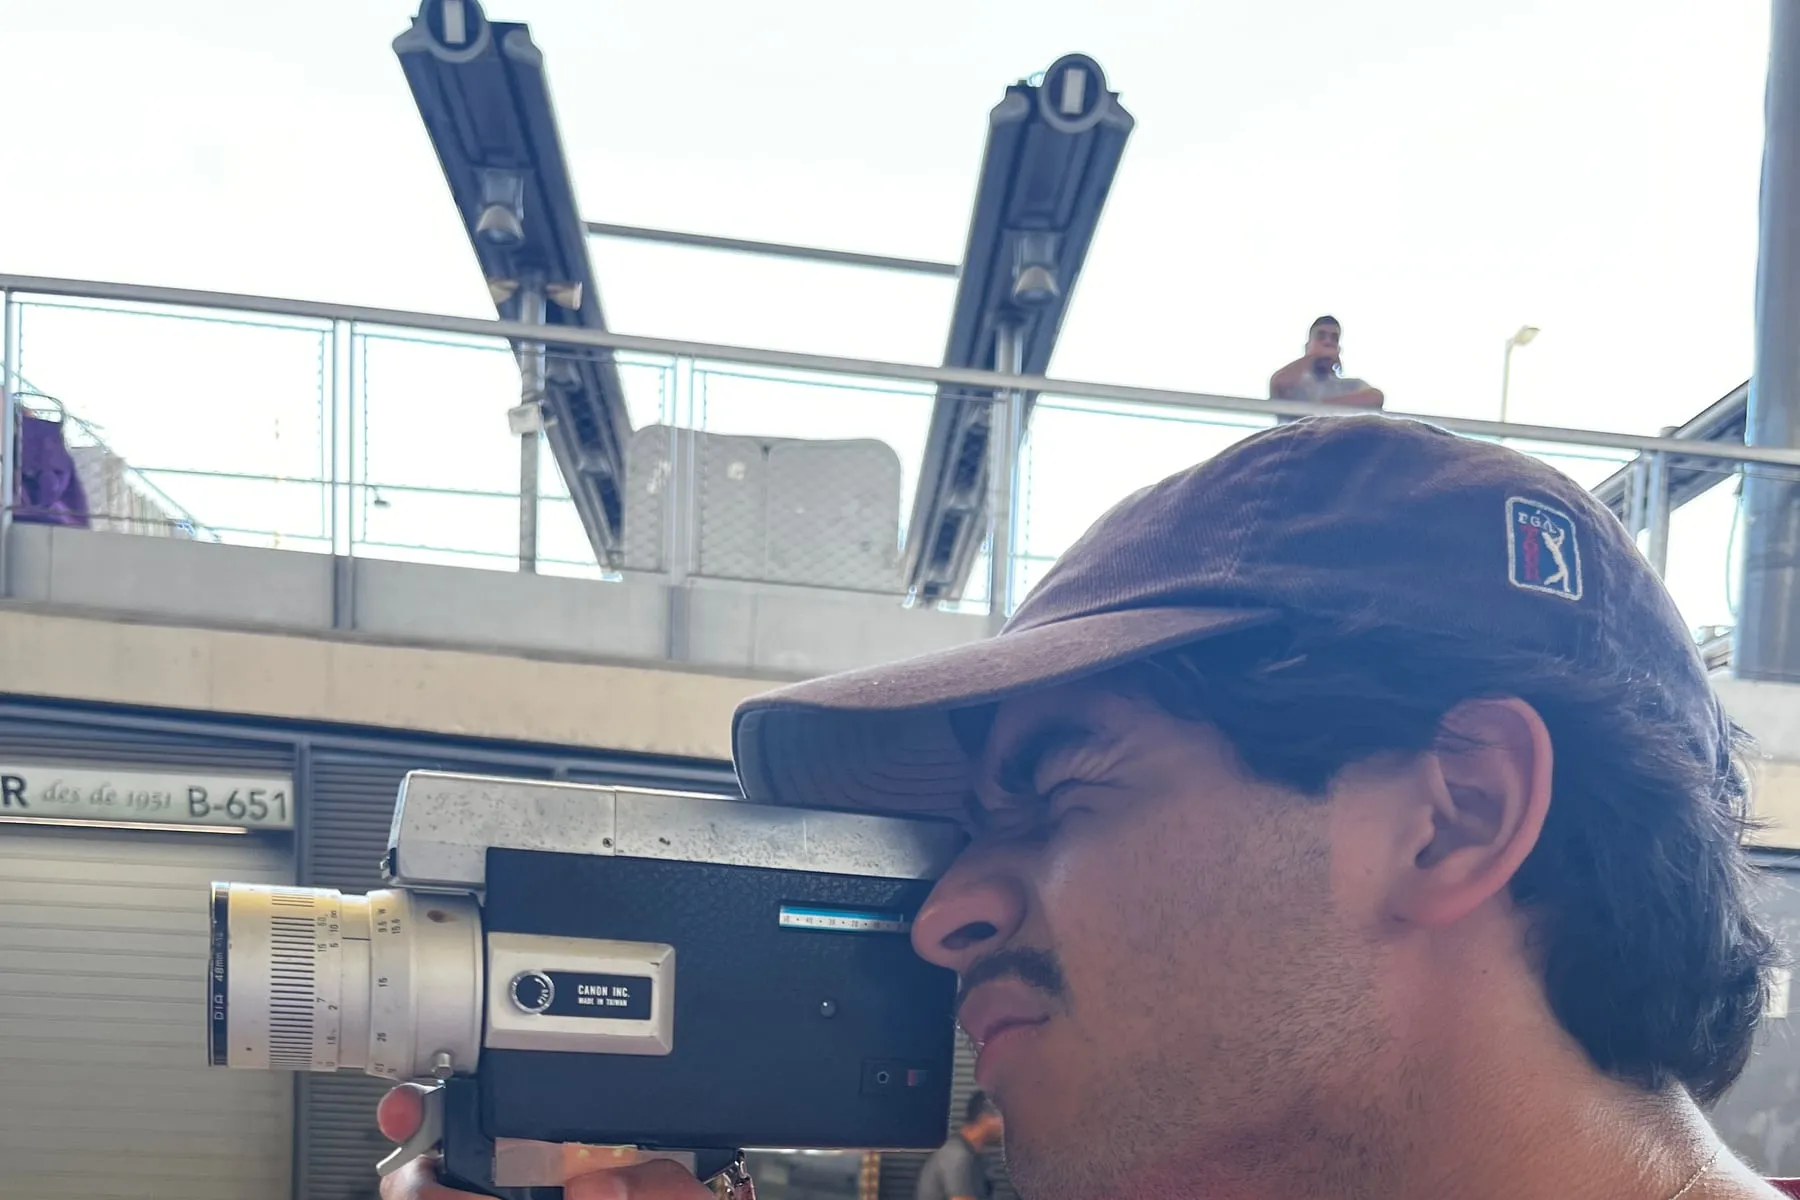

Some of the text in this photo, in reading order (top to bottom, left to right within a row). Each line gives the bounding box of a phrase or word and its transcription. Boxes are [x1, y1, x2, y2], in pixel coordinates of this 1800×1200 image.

[0, 775, 30, 809] R
[89, 780, 118, 808] de
[187, 784, 287, 822] B-651
[577, 984, 631, 998] CANON INC.
[214, 993, 224, 1020] DIA
[578, 997, 628, 1007] MADE IN TAIWAN
